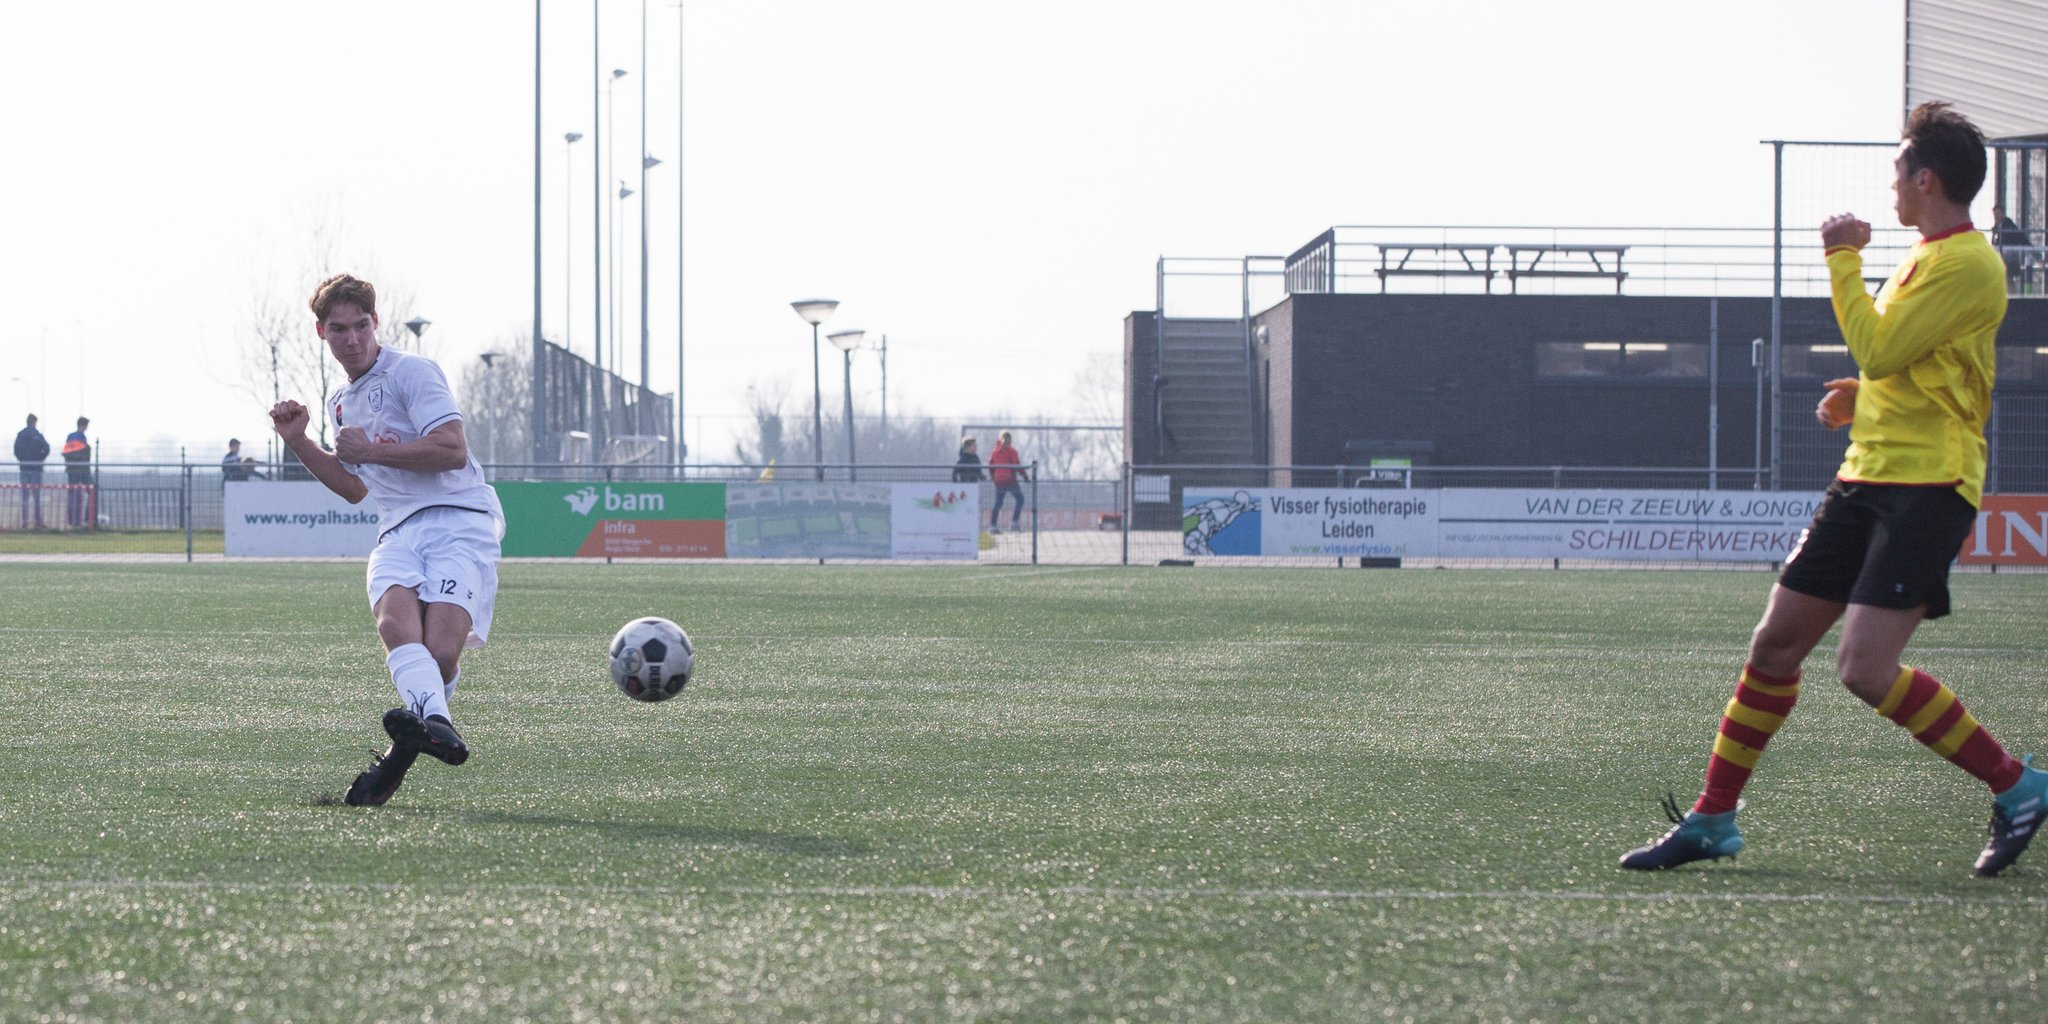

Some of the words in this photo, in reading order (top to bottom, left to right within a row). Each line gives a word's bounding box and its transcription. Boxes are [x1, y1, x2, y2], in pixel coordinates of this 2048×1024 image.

[604, 487, 665, 512] bam
[1271, 497, 1319, 514] Visser
[1324, 496, 1427, 519] fysiotherapie
[1525, 498, 1571, 515] VAN
[1576, 498, 1623, 515] DER
[1630, 498, 1715, 516] ZEEUW
[1719, 499, 1734, 516] &
[245, 510, 380, 528] www.royalhasko
[604, 521, 636, 535] infra
[1322, 521, 1375, 539] Leiden
[1290, 543, 1407, 555] www.visserfysio.nl
[439, 578, 457, 595] 12
